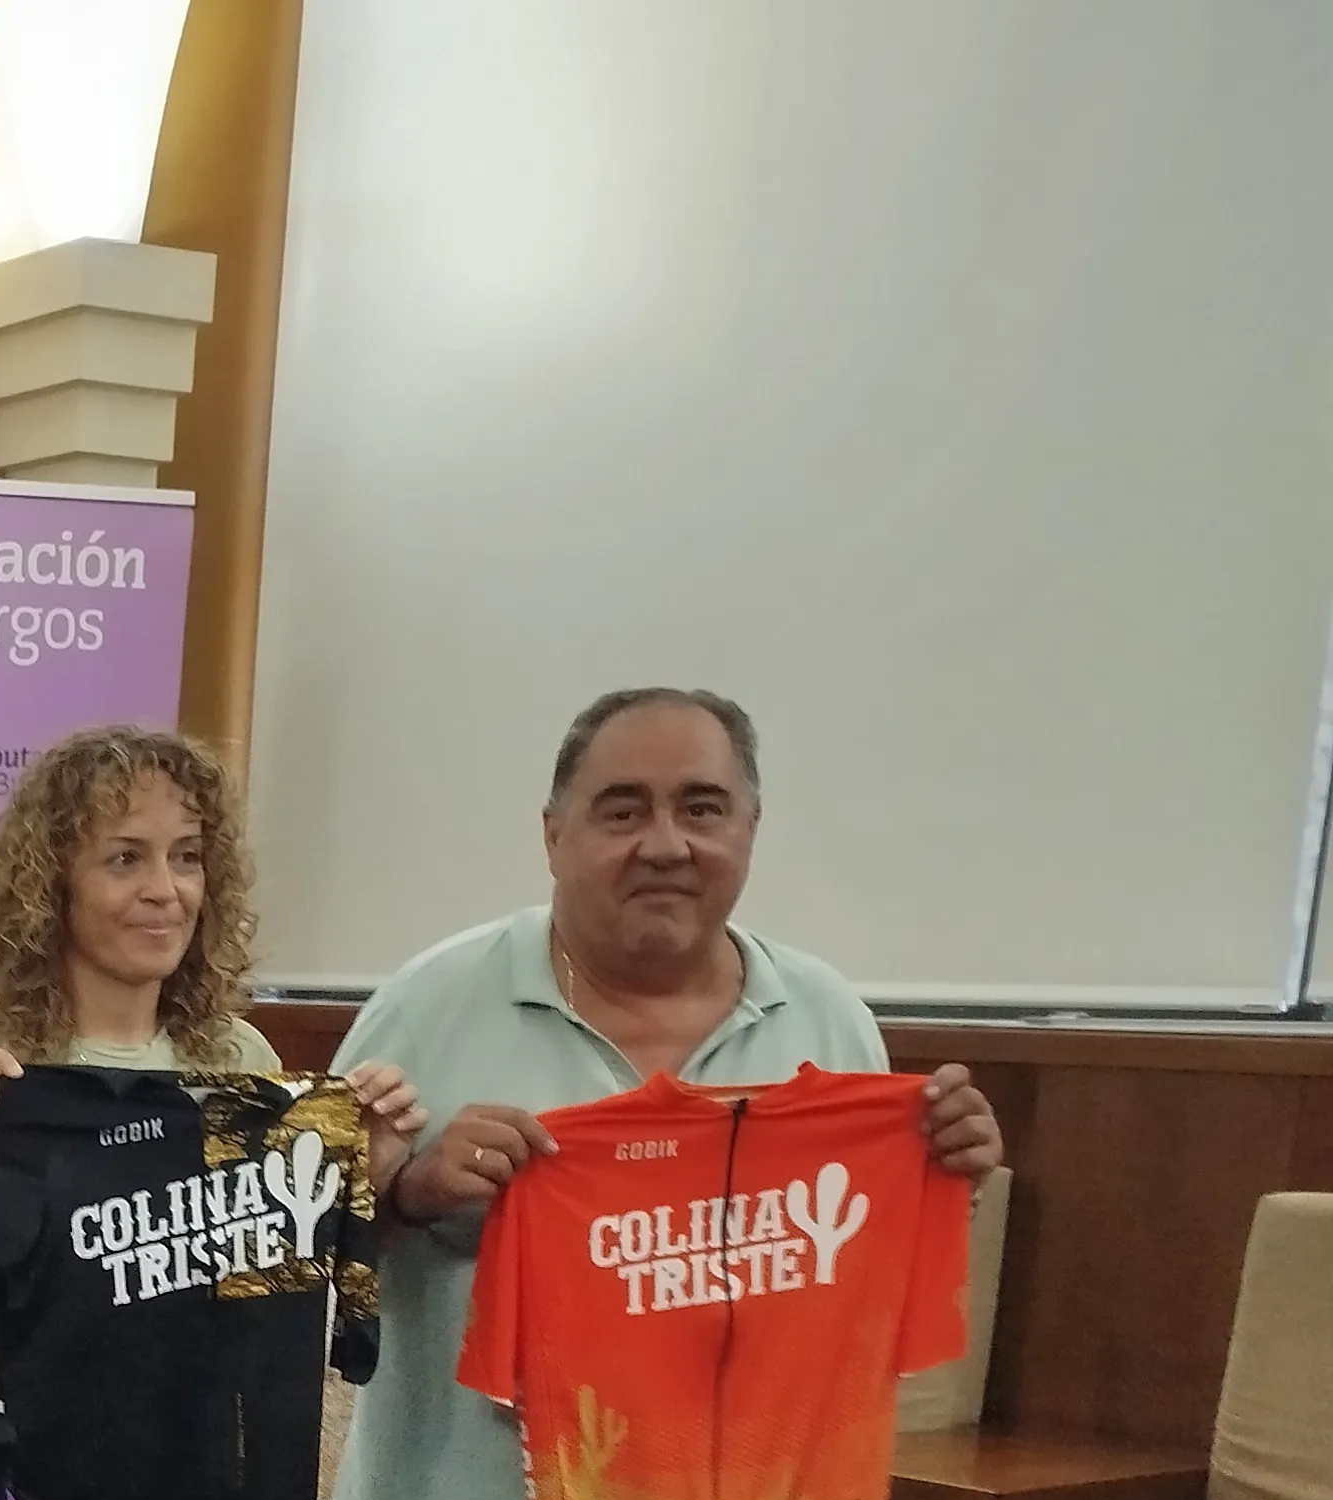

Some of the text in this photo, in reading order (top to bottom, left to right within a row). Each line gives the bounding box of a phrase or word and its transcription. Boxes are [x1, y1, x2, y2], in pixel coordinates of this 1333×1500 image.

[614, 1139, 679, 1161] GOBIK
[69, 1161, 270, 1262] COLINA
[587, 1189, 793, 1269] COLINA
[101, 1211, 286, 1307] TRISTE
[617, 1239, 811, 1316] TRISTE
